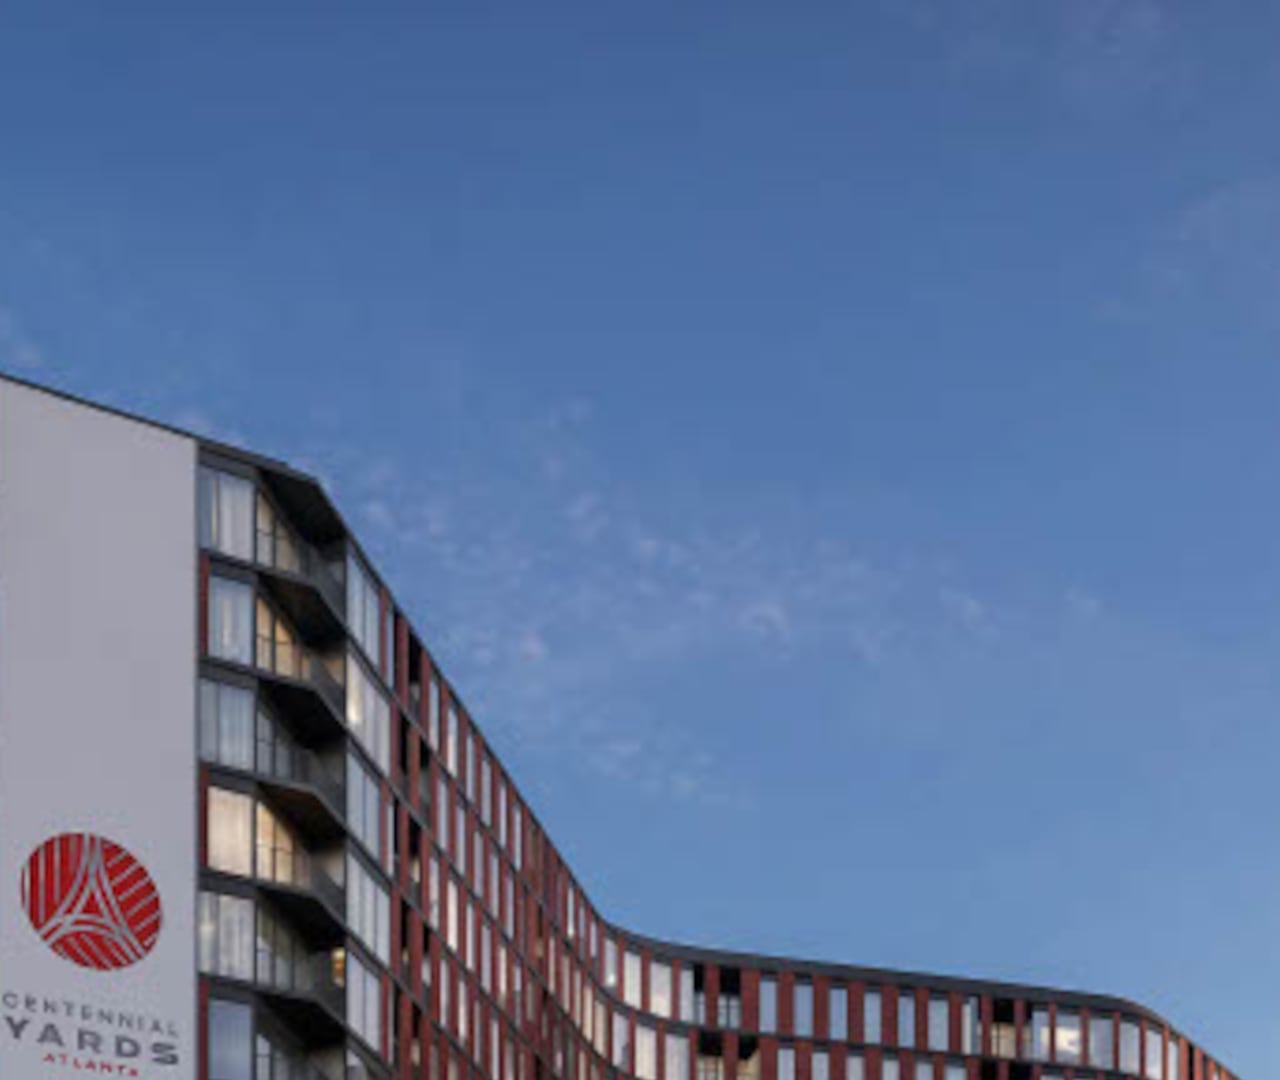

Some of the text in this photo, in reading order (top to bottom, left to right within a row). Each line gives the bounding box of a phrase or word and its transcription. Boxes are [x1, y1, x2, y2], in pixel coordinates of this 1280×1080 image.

[2, 992, 179, 1038] CENTENNIAL
[4, 1015, 179, 1066] YARDS
[42, 1053, 139, 1077] ATLANTA
